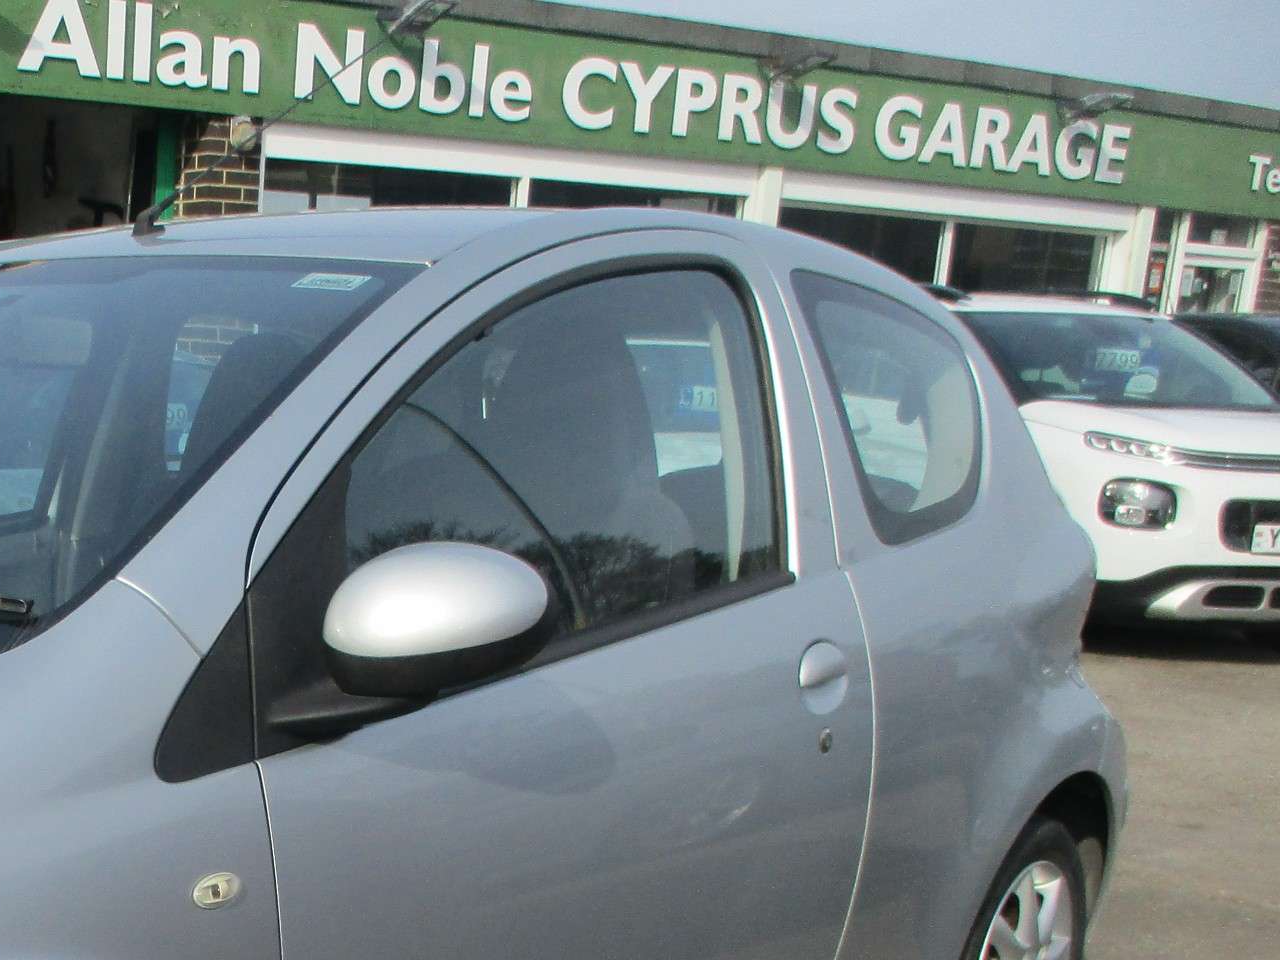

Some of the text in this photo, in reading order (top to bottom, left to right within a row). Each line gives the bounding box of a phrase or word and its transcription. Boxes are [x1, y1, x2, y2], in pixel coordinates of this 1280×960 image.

[17, 0, 1132, 184] Allan Noble CYPRUS GARAGE
